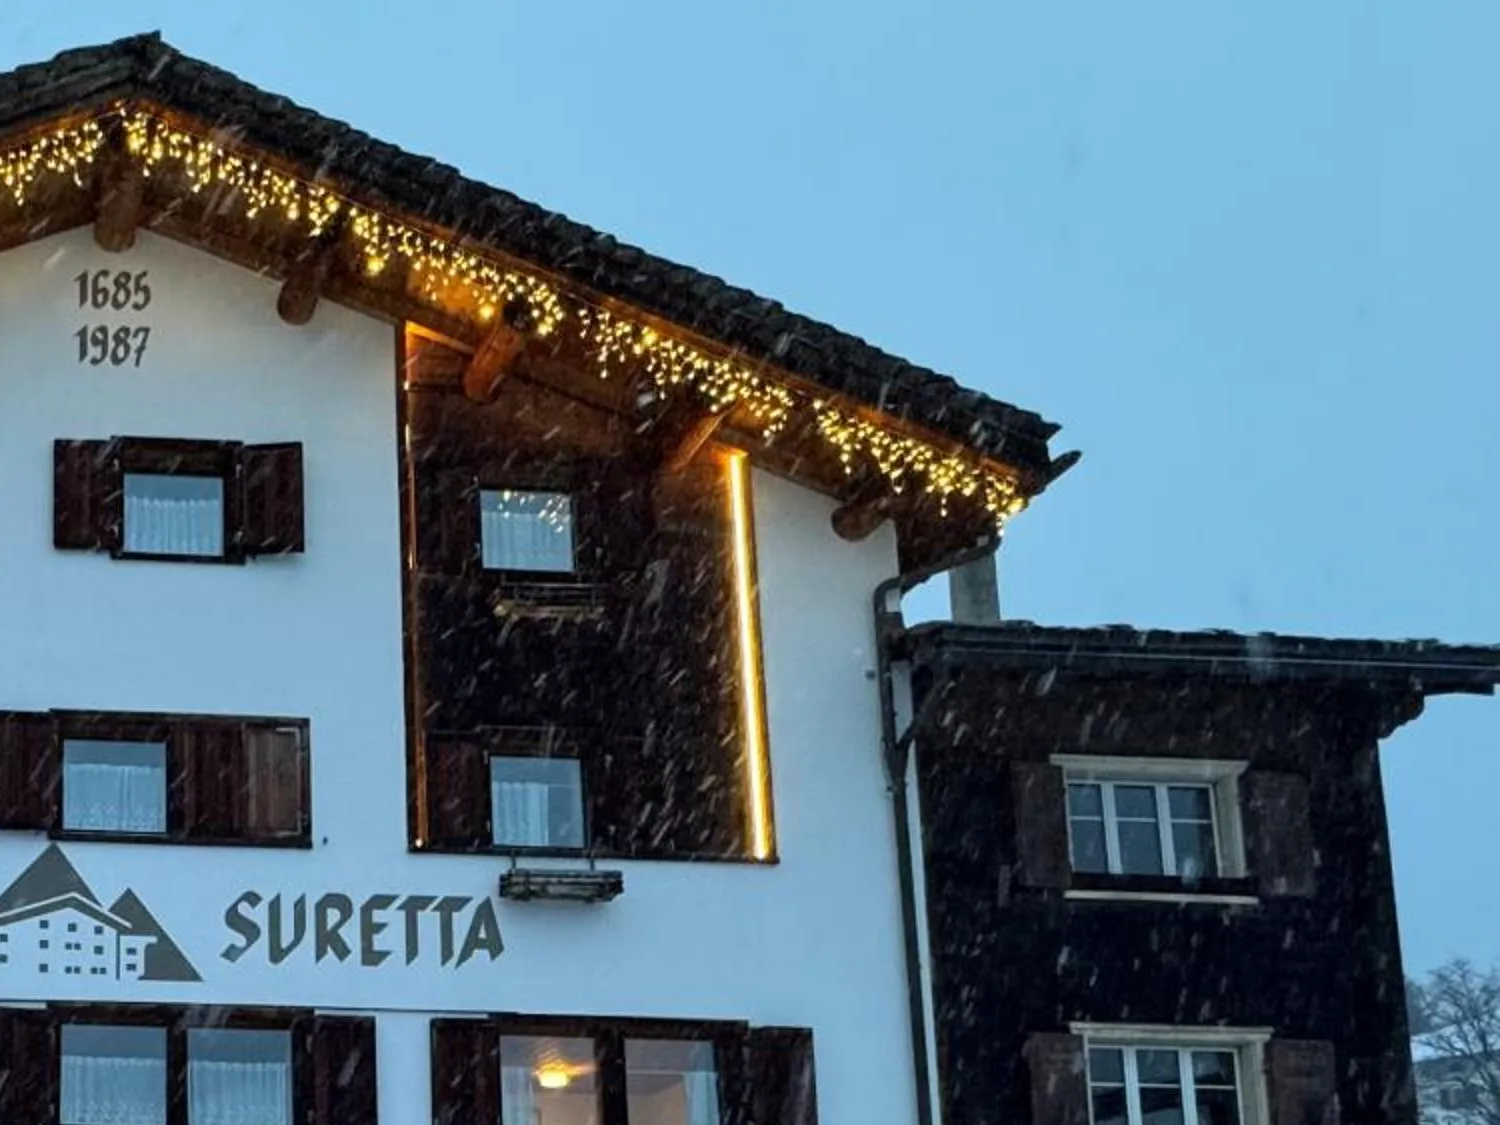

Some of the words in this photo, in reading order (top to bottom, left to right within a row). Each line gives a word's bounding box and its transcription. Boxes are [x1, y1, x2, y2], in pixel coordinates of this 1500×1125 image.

[74, 269, 151, 312] 1685
[73, 324, 151, 368] 1987
[219, 890, 506, 971] SURETTA
